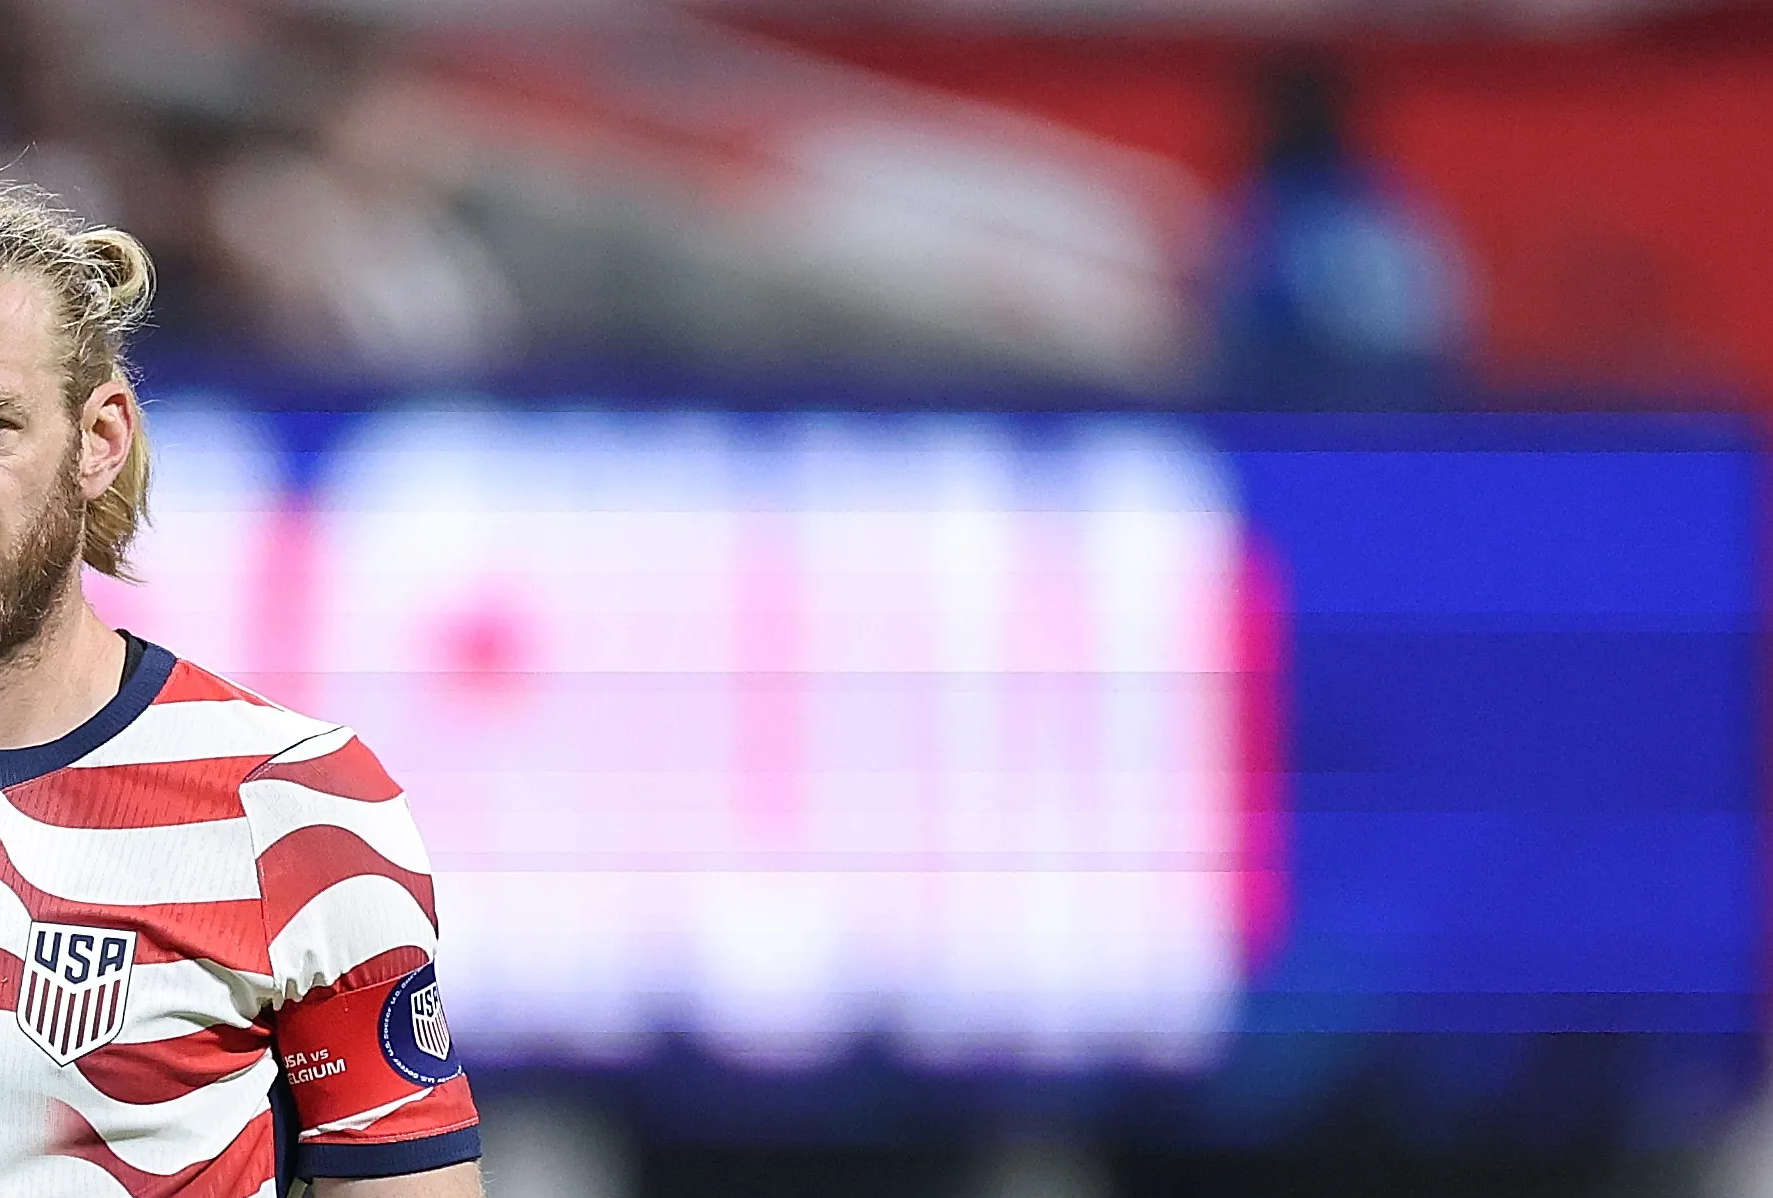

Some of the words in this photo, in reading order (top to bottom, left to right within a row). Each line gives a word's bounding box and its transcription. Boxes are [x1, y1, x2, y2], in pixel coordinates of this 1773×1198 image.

[34, 930, 128, 985] USA
[310, 1048, 329, 1062] vs
[287, 1058, 347, 1085] ELGIUM
